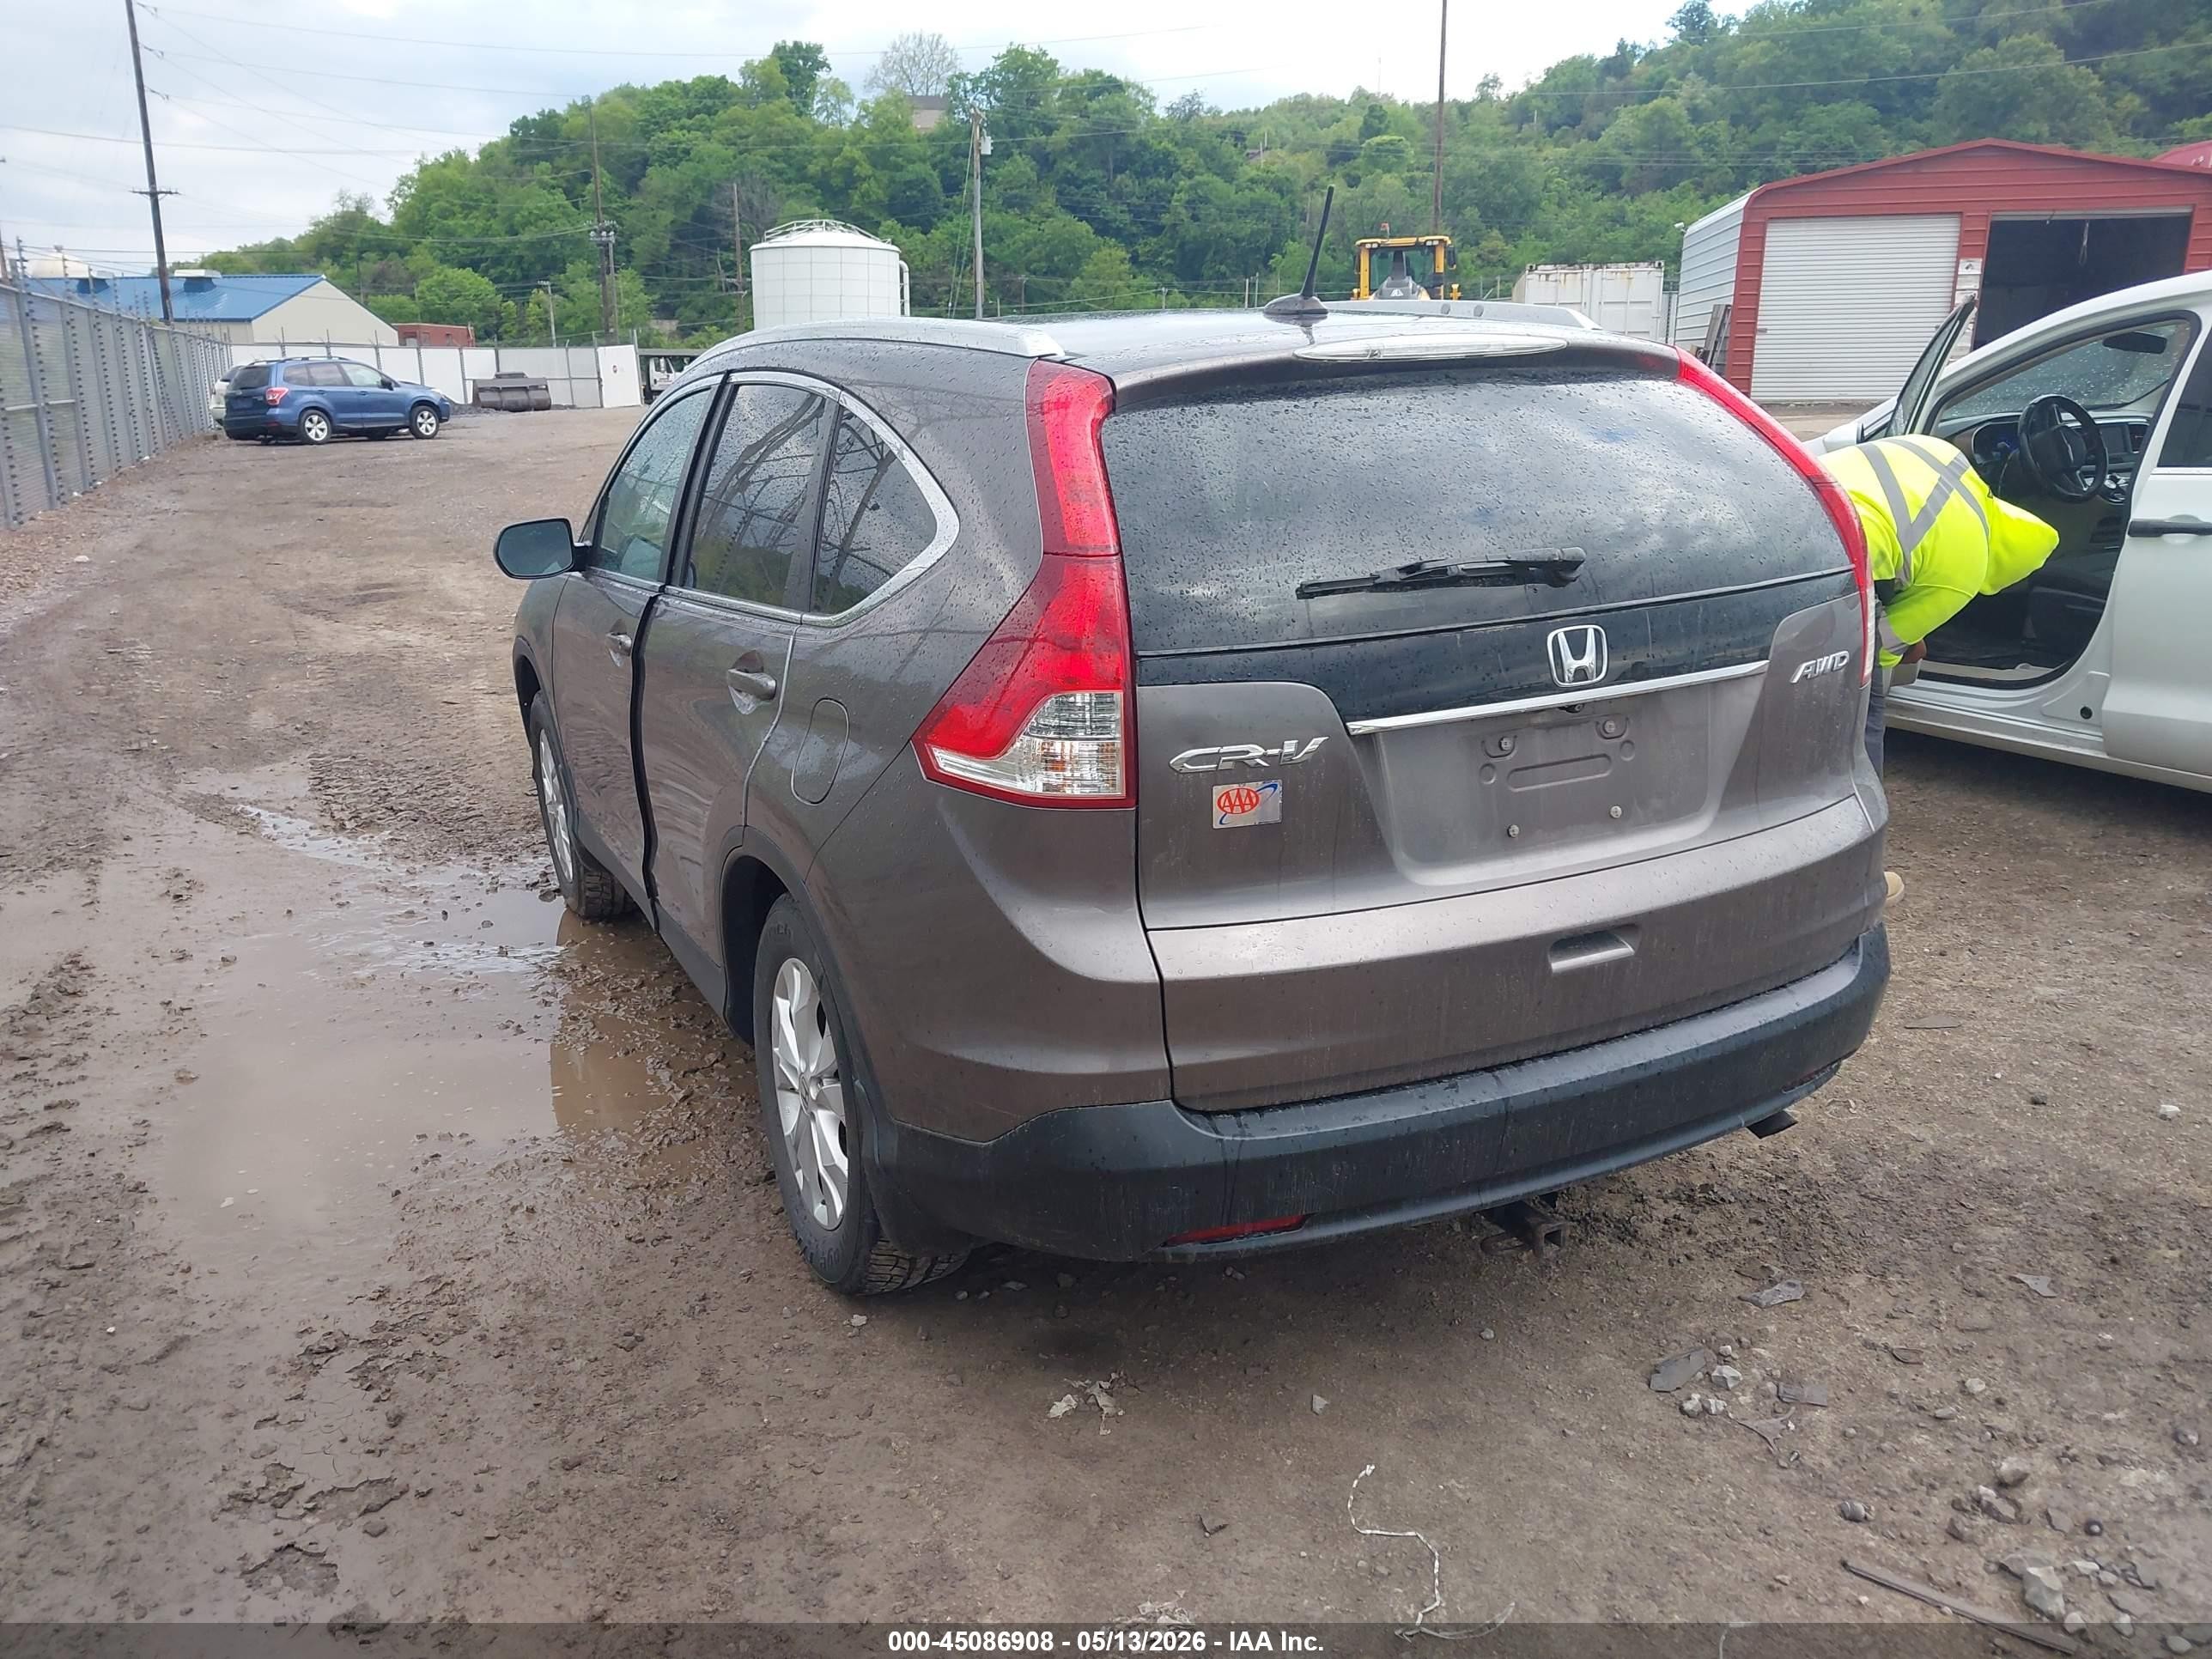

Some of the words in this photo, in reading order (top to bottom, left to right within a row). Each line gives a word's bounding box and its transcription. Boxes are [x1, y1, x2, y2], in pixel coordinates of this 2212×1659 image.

[1789, 649, 1850, 684] AWD
[1169, 736, 1330, 774] CR-V
[1219, 787, 1257, 814] AAA
